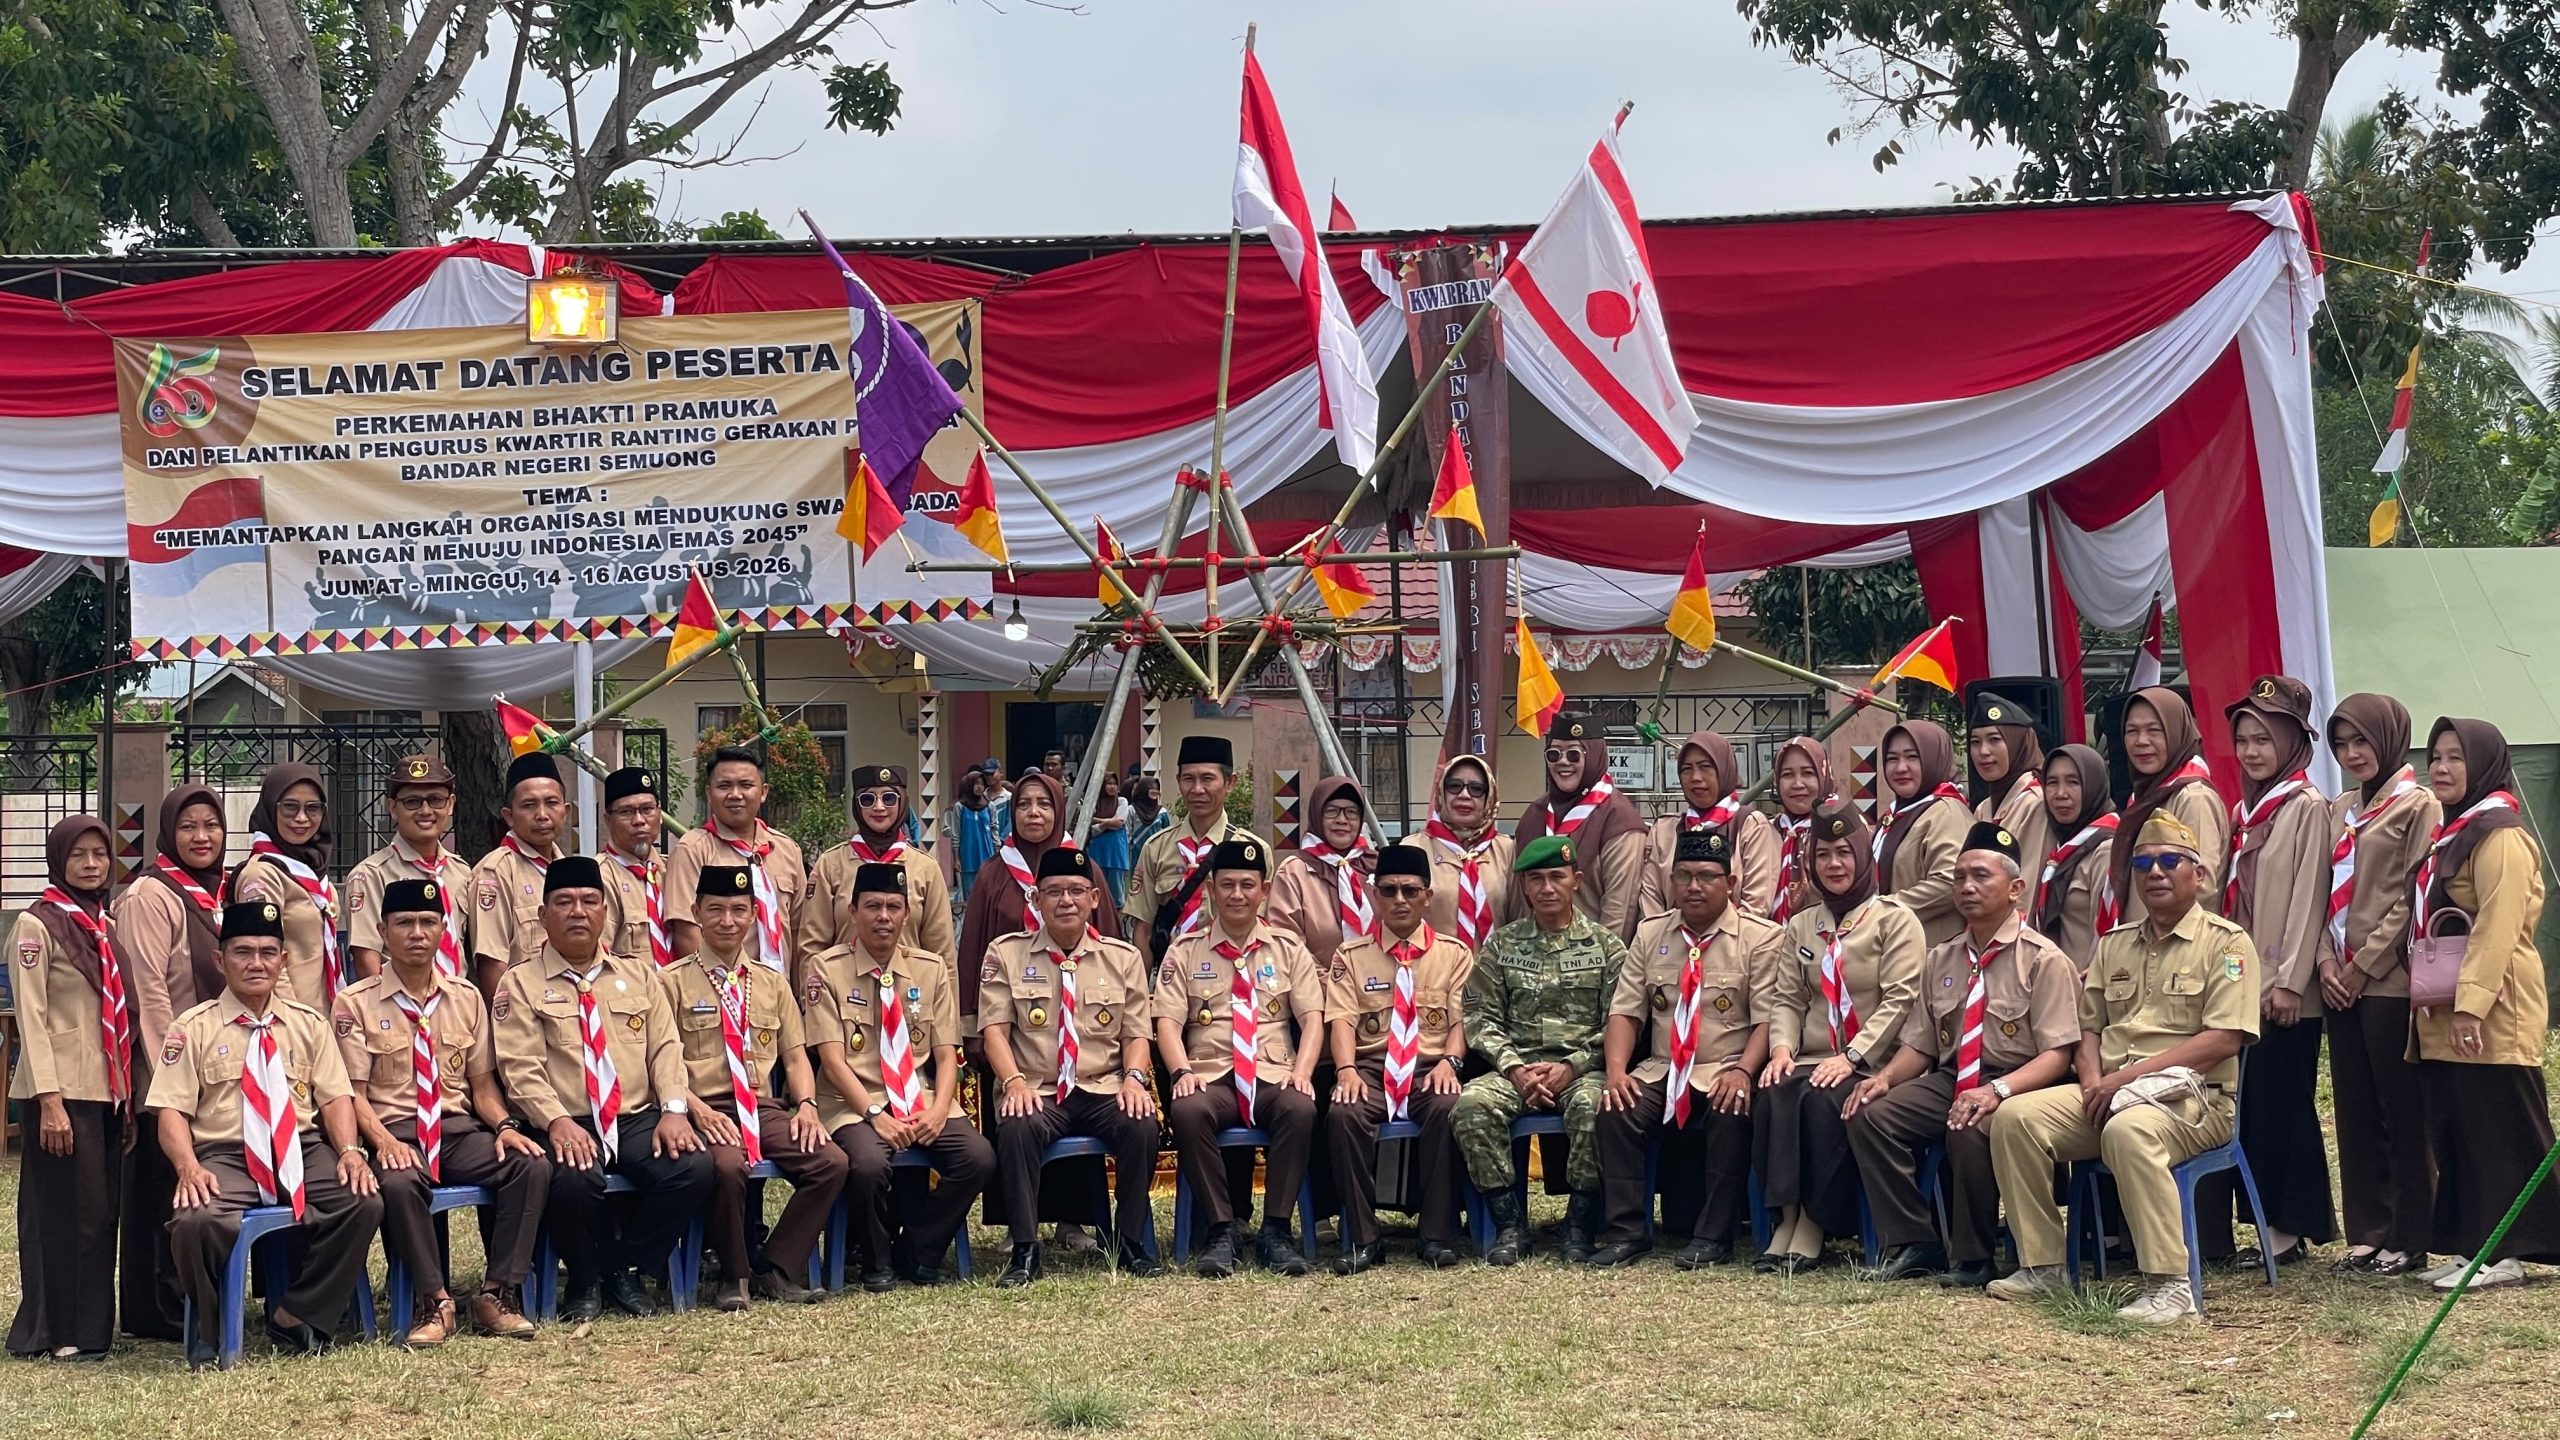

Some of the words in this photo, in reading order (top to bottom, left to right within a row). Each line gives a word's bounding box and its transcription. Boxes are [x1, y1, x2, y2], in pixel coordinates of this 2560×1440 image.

[1410, 280, 1491, 312] KWARRAN
[244, 362, 443, 397] SELAMAT
[461, 352, 630, 388] DATANG
[648, 344, 840, 379] PESERTA
[337, 411, 523, 435] PERKEMAHAN
[533, 405, 634, 426] BHAKTI
[645, 399, 777, 421] PRAMUKA
[149, 449, 194, 467] DAN
[203, 445, 350, 464] PELANTIKAN
[360, 438, 487, 458] PENGURUS
[497, 433, 602, 452] KWARTIR
[612, 428, 715, 447] RANTING
[725, 421, 836, 440] GERAKAN
[402, 462, 496, 480] BANDAR
[506, 457, 590, 475] NEGERI
[600, 450, 716, 470] SEMUONG
[523, 487, 592, 506] TEMA
[156, 524, 348, 548] “MEMANTAPKAN
[358, 519, 472, 540] LANGKAH
[481, 511, 625, 533] ORGANISASI
[645, 503, 787, 525] MENDUKUNG
[319, 547, 415, 565] PANGAN
[424, 541, 521, 560] MENUJU
[532, 536, 659, 555] INDONESIA
[670, 530, 734, 548] EMAS
[427, 572, 527, 593] MINGGU,
[535, 569, 561, 586] 14
[583, 567, 610, 584] 16
[618, 562, 728, 582] AGUSTUS
[736, 557, 791, 576] 2026
[1563, 960, 1581, 969] TNI
[1588, 956, 1603, 965] AD
